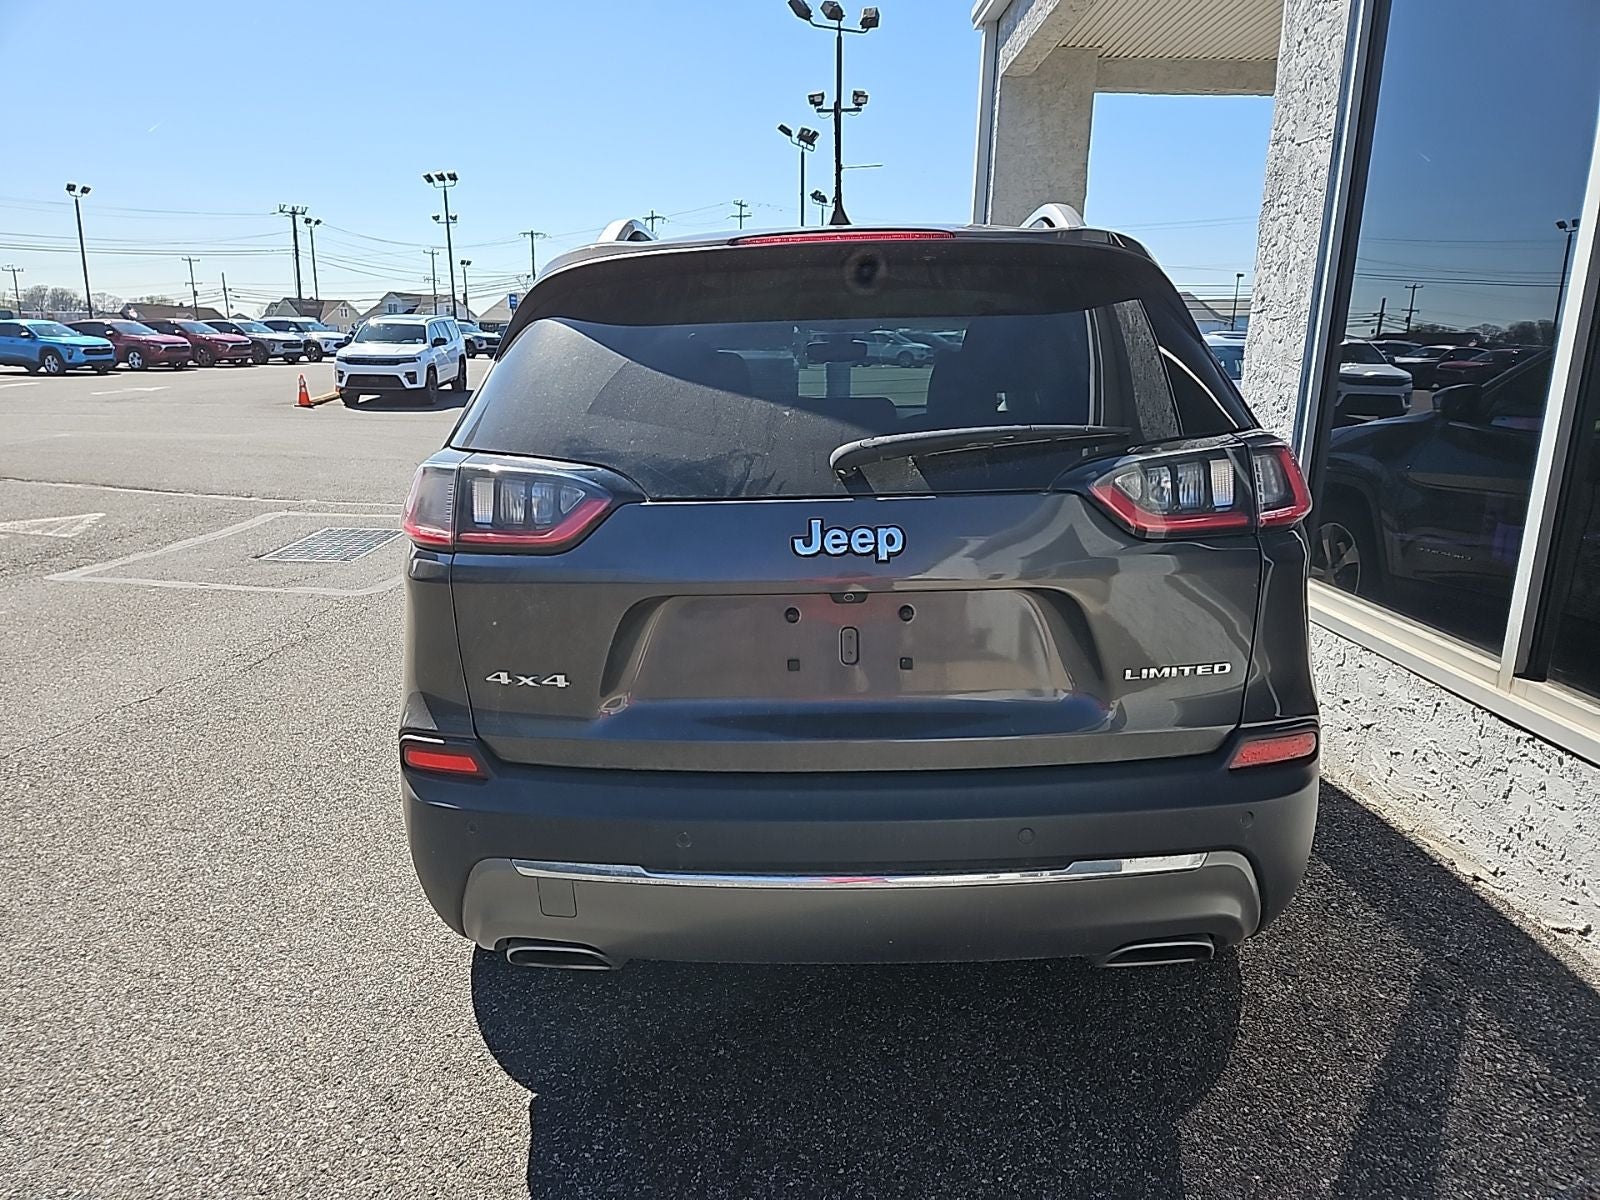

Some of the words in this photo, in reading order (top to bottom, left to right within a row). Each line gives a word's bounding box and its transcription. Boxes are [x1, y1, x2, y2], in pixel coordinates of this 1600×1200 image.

[792, 518, 905, 562] Jeep
[485, 671, 570, 688] 4x4
[1124, 662, 1232, 680] LIMITED
